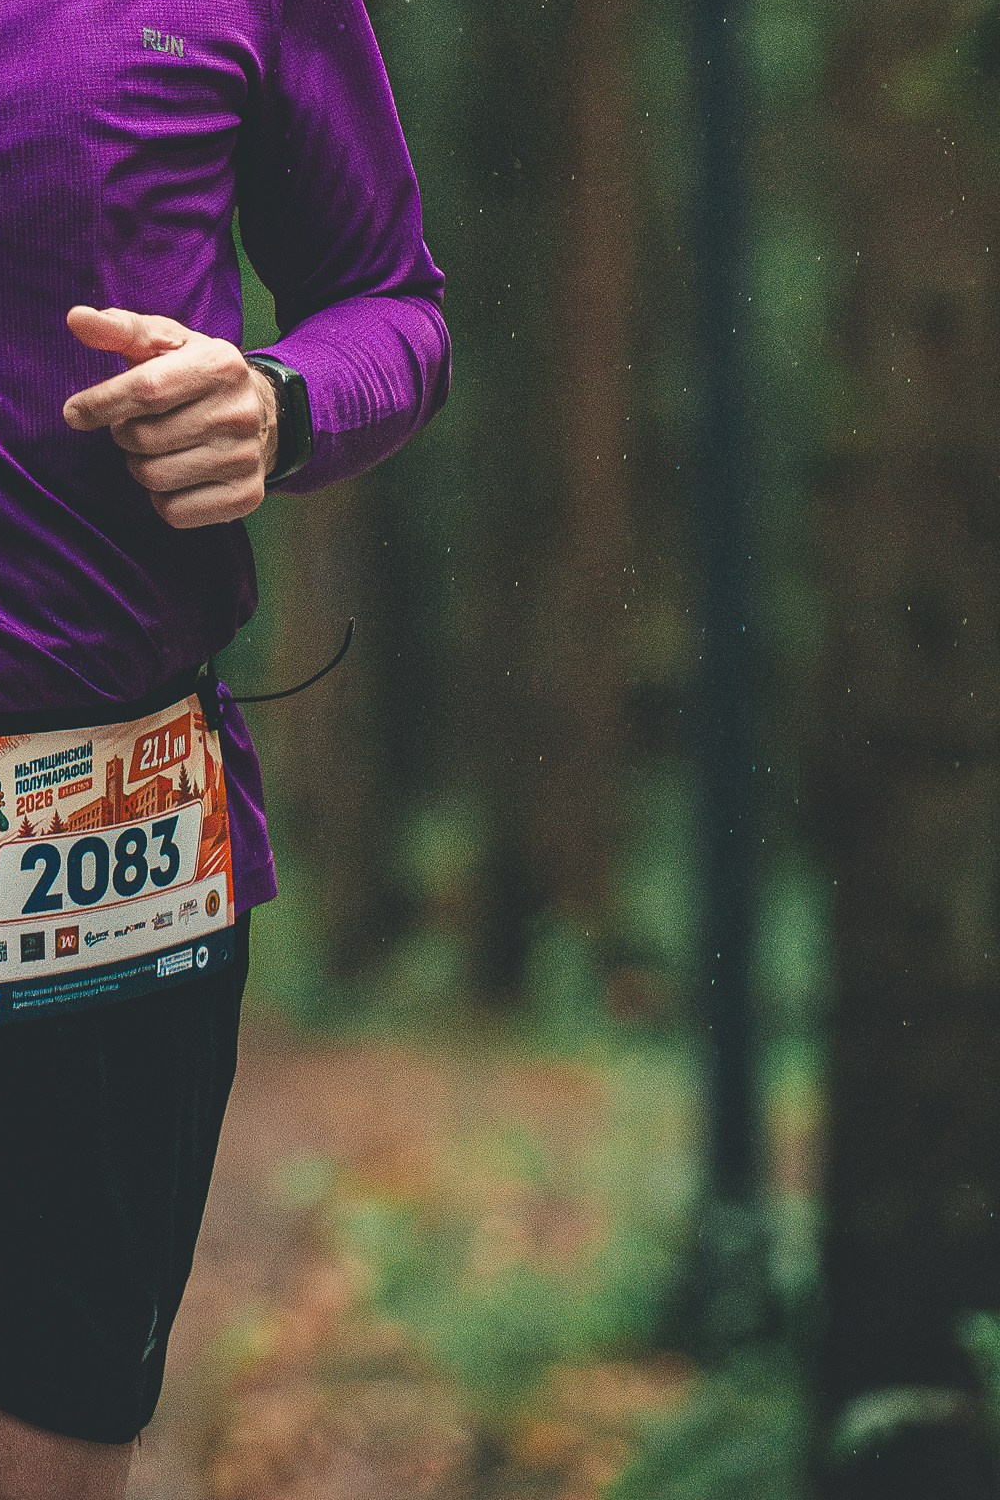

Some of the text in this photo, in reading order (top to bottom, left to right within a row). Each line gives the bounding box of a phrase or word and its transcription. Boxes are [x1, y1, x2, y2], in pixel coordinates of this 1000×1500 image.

[142, 27, 185, 58] RUN
[15, 740, 93, 779] МЫТИЩИНСКИЙ
[140, 731, 171, 771] 21,1
[15, 759, 93, 795] ПОЛУМАРАФОН
[16, 788, 54, 817] 2026
[21, 815, 180, 915] 2083
